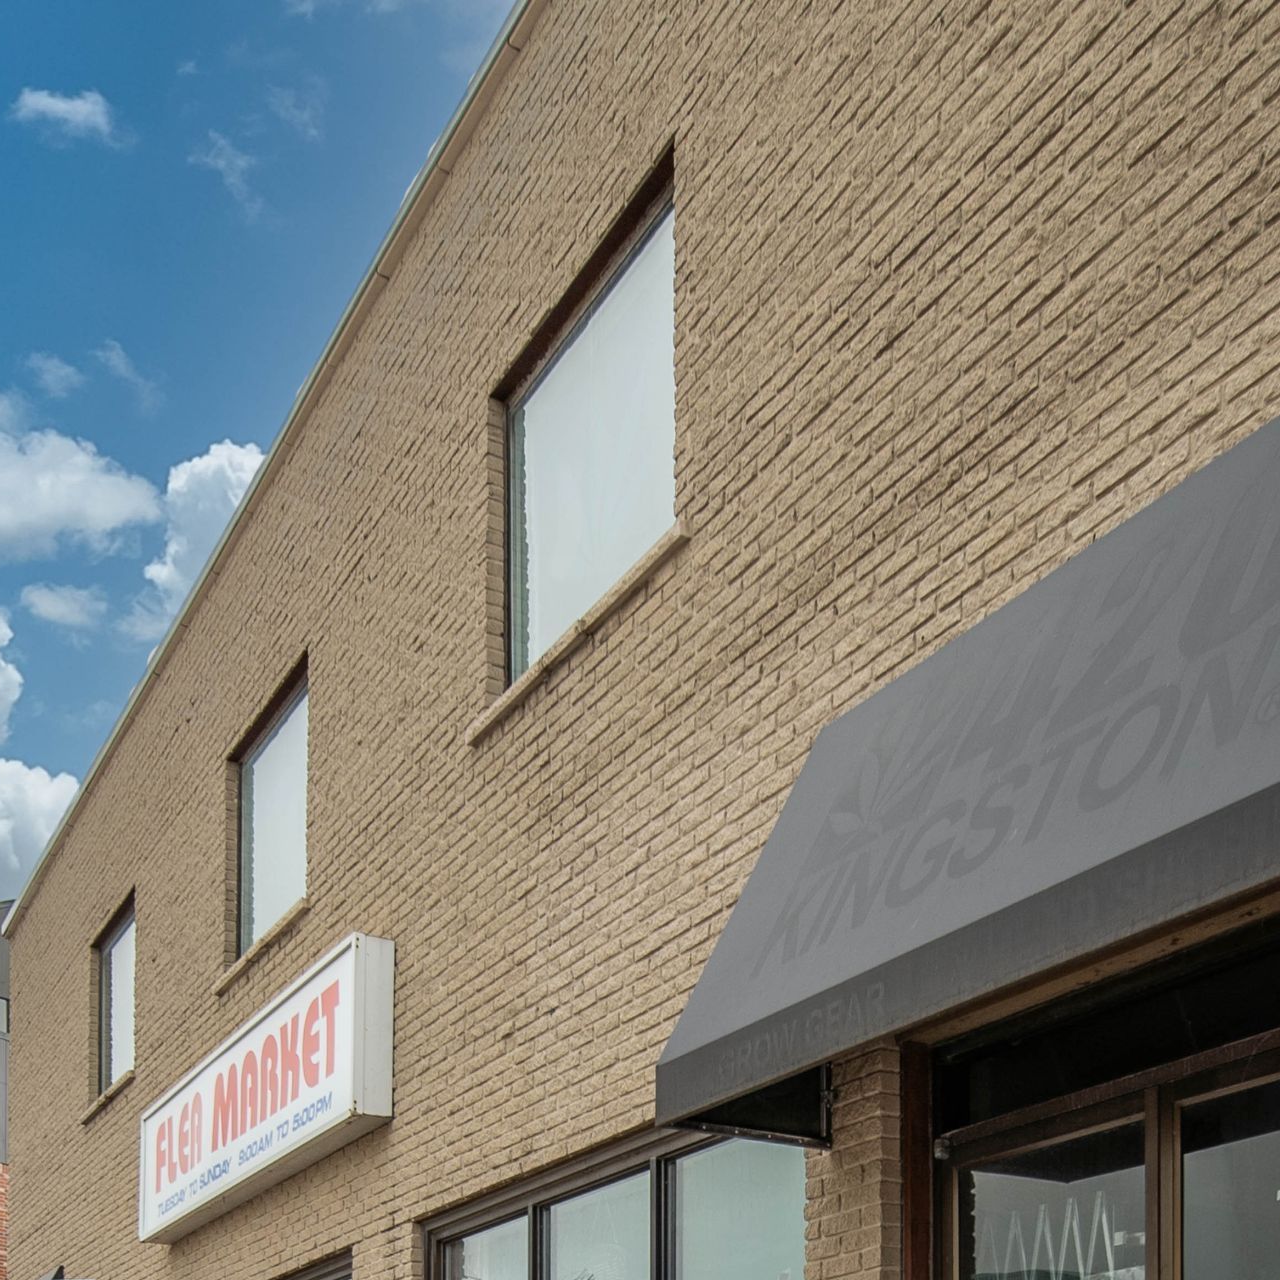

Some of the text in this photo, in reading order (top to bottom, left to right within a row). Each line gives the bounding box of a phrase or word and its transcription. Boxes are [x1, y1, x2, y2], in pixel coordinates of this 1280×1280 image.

[155, 979, 340, 1194] FLEA MARKET
[718, 978, 887, 1087] GROW GEAR
[199, 1156, 232, 1190] SUNDAY
[276, 1119, 289, 1142] TO
